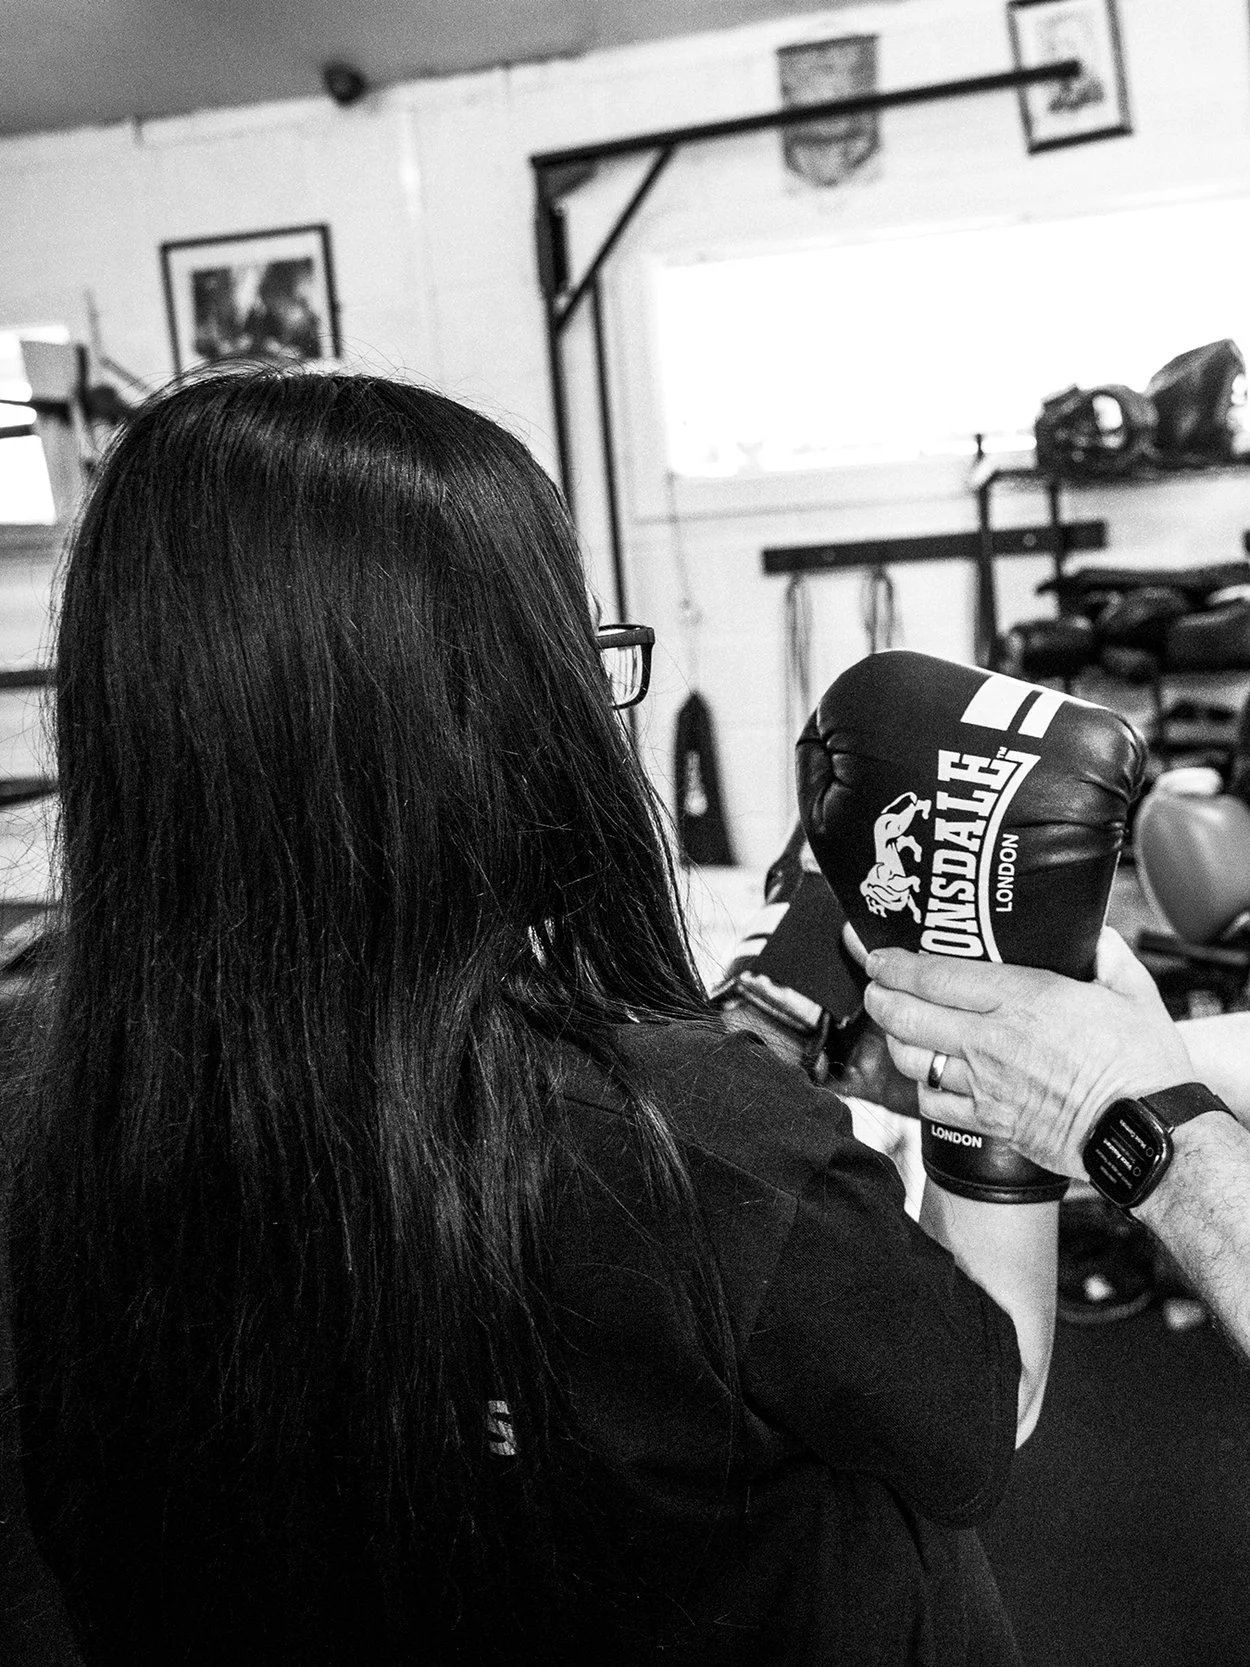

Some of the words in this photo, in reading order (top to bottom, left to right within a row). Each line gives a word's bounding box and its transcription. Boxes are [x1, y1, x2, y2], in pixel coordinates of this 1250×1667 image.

[919, 749, 1018, 957] ONSDALE
[996, 833, 1019, 912] LONDON
[930, 1124, 983, 1148] LONDON
